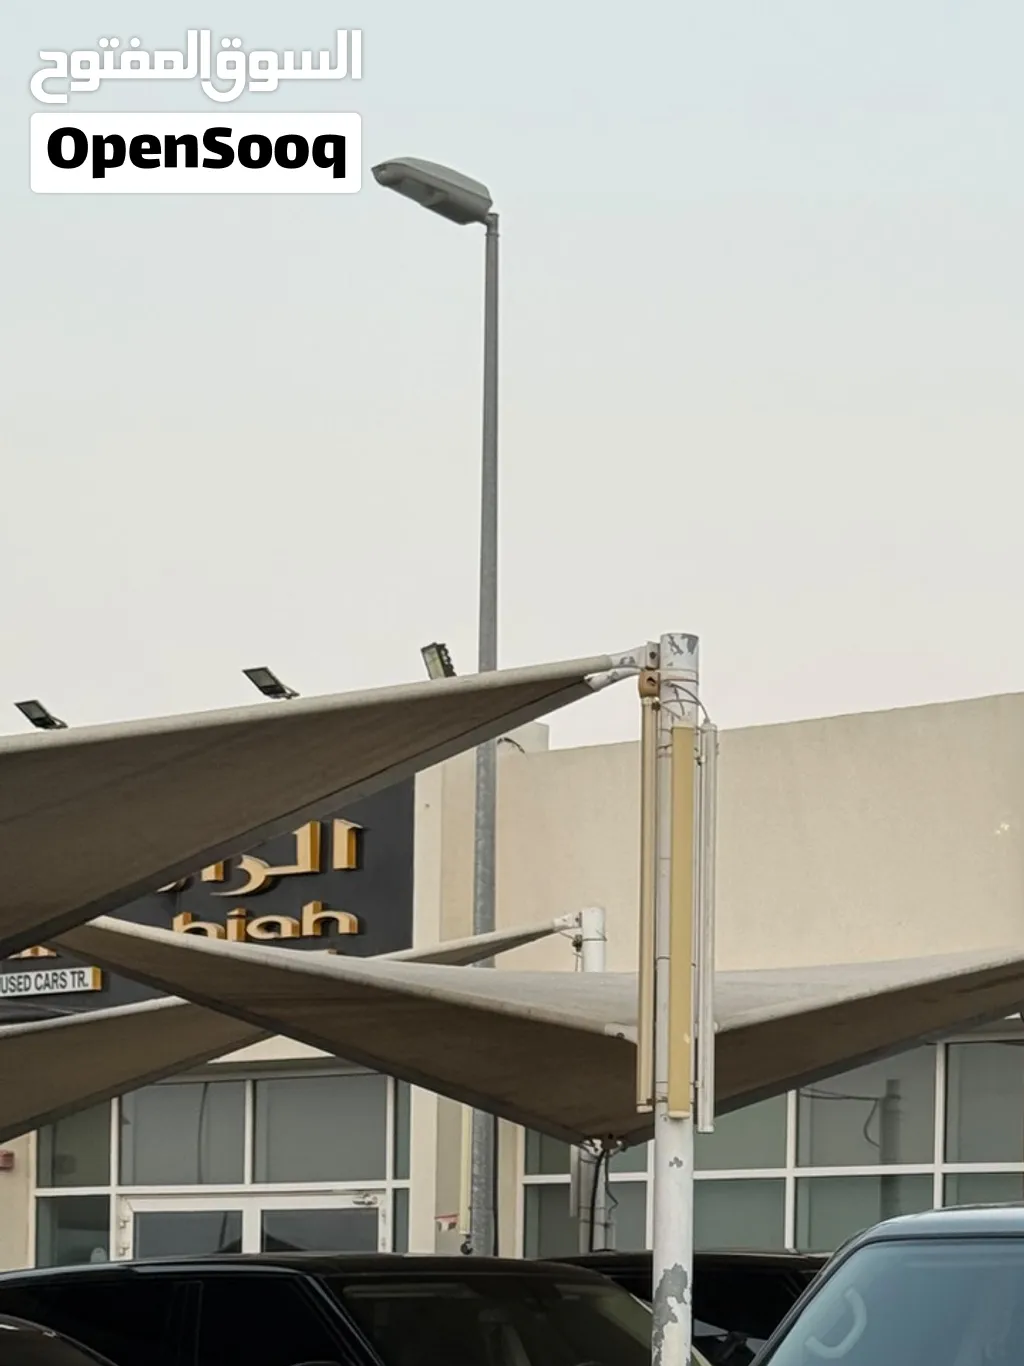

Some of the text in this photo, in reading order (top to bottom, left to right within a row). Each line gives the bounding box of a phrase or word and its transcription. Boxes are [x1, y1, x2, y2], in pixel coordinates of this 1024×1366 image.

[1, 970, 89, 993] USED CARS TR.
